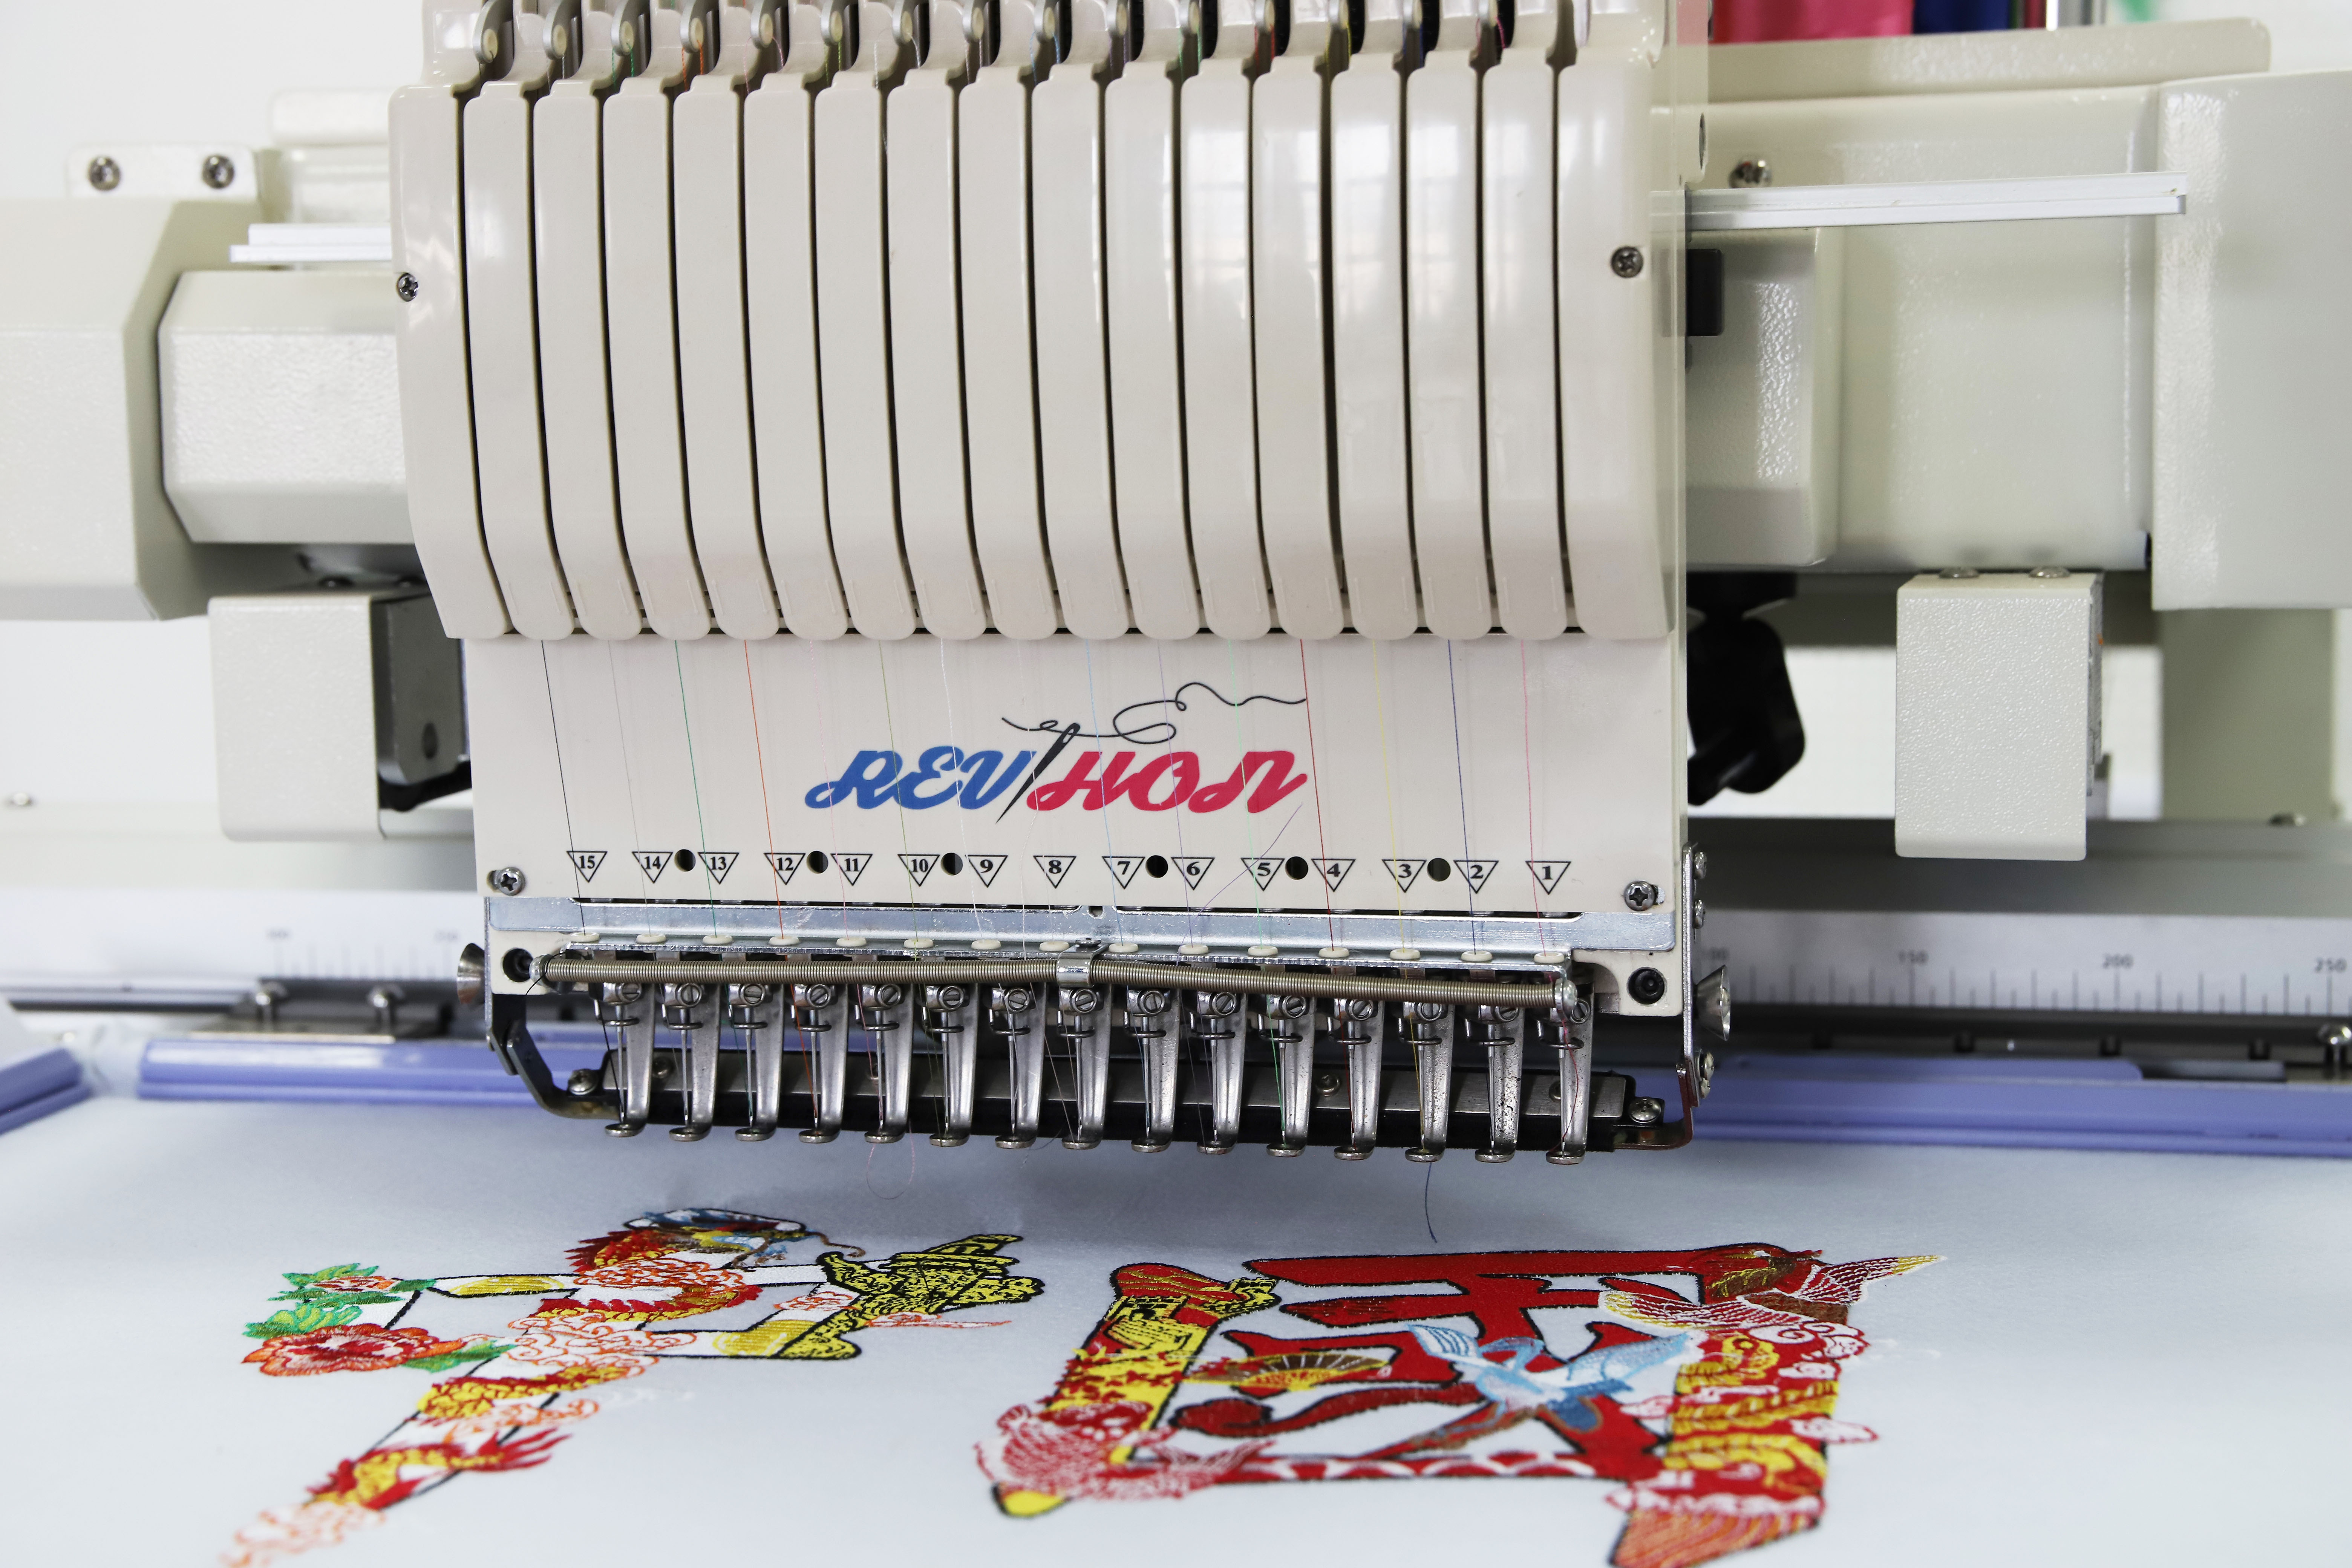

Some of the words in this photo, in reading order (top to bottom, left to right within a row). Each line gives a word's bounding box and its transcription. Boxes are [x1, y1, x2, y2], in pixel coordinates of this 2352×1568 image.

[579, 855, 596, 869] 15
[644, 856, 661, 870] 14
[710, 856, 727, 871] 13
[776, 857, 793, 872] 12
[844, 858, 859, 872] 11
[911, 858, 929, 873] 10
[980, 859, 994, 874] 9
[1048, 859, 1062, 874] 8
[1117, 861, 1131, 875] 7
[1186, 861, 1200, 876] 6
[1257, 862, 1271, 877] 5
[1326, 862, 1341, 877] 4
[1398, 864, 1413, 878] 3
[1469, 864, 1484, 879] 2
[1541, 866, 1554, 880] 1
[2102, 953, 2133, 969] 200
[2314, 957, 2347, 972] 250
